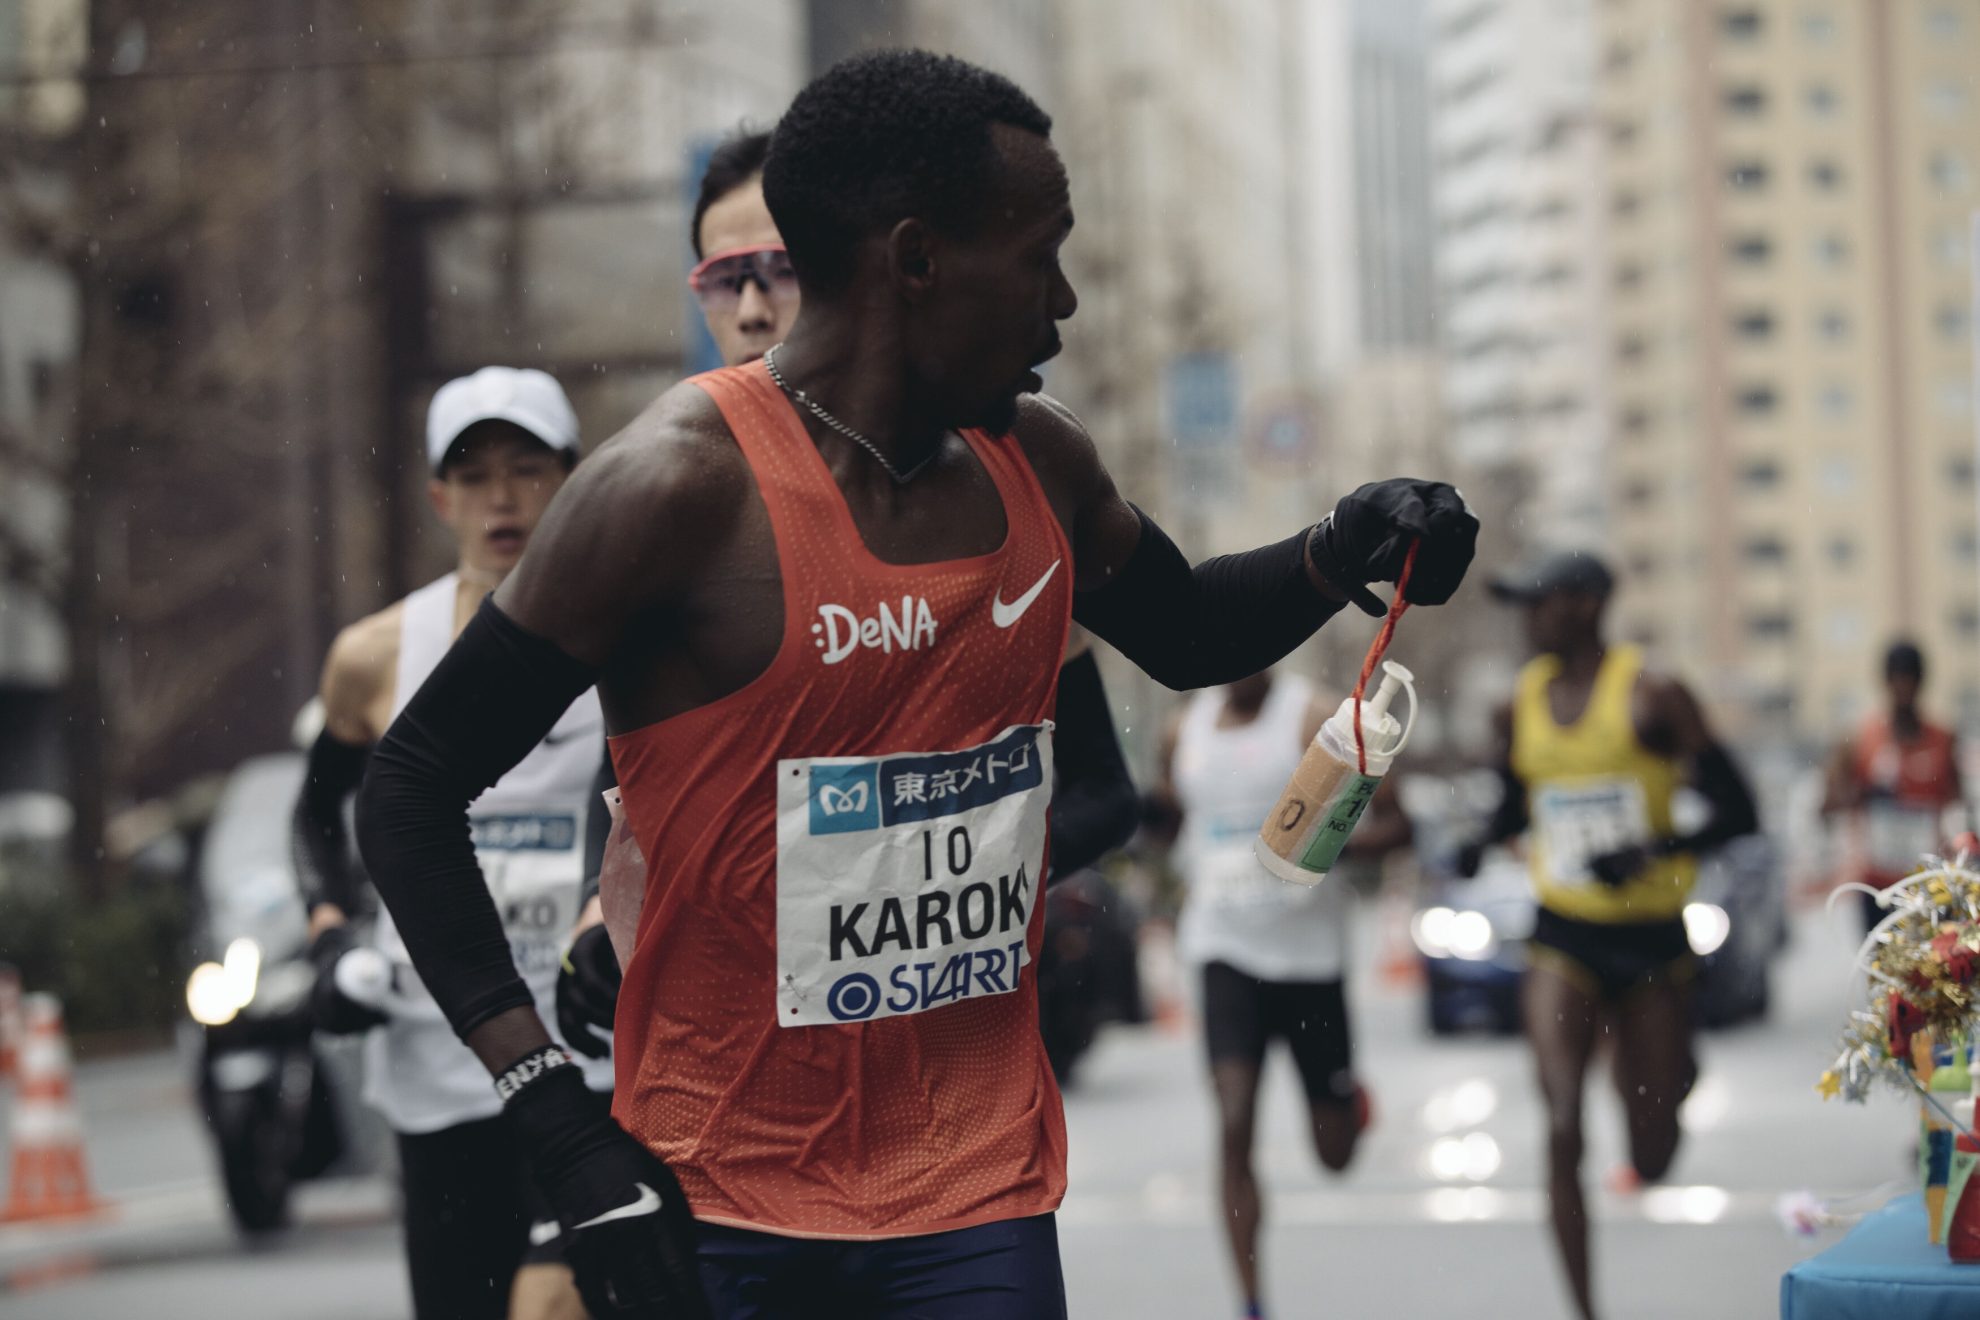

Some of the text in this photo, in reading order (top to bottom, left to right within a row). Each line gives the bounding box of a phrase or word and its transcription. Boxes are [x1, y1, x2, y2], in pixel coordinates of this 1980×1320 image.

[893, 743, 1030, 806] 東京メトロ
[923, 826, 972, 881] 10
